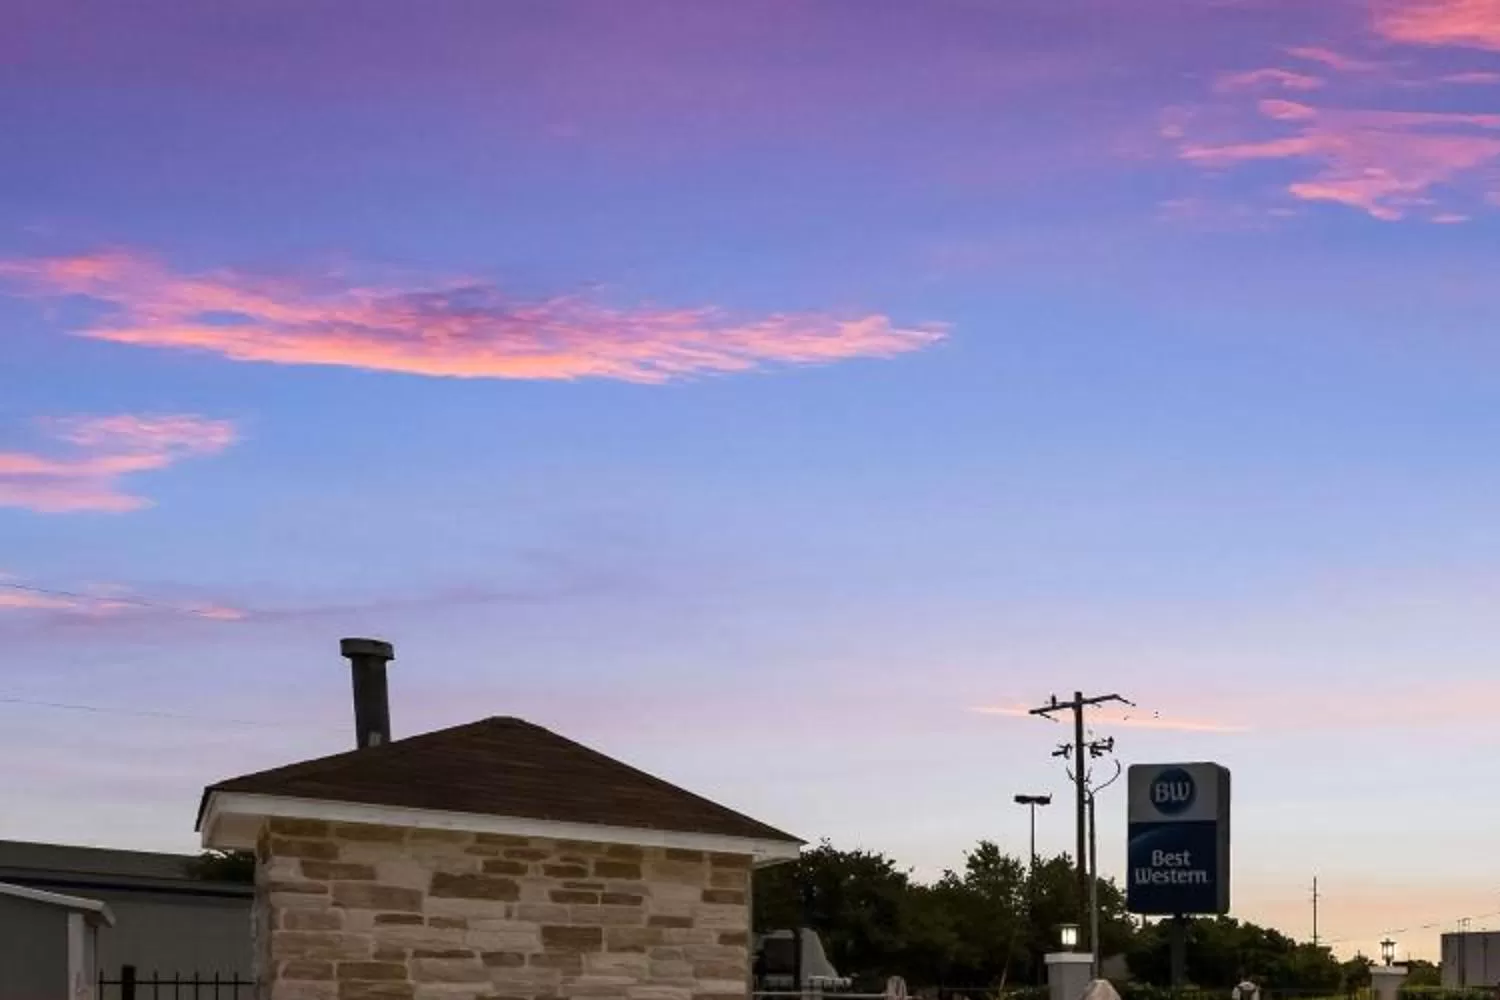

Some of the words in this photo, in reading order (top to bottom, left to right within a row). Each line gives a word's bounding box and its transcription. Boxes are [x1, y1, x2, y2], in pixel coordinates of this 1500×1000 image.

[1155, 781, 1190, 803] BW
[1151, 849, 1192, 867] Best
[1134, 867, 1209, 885] Western
